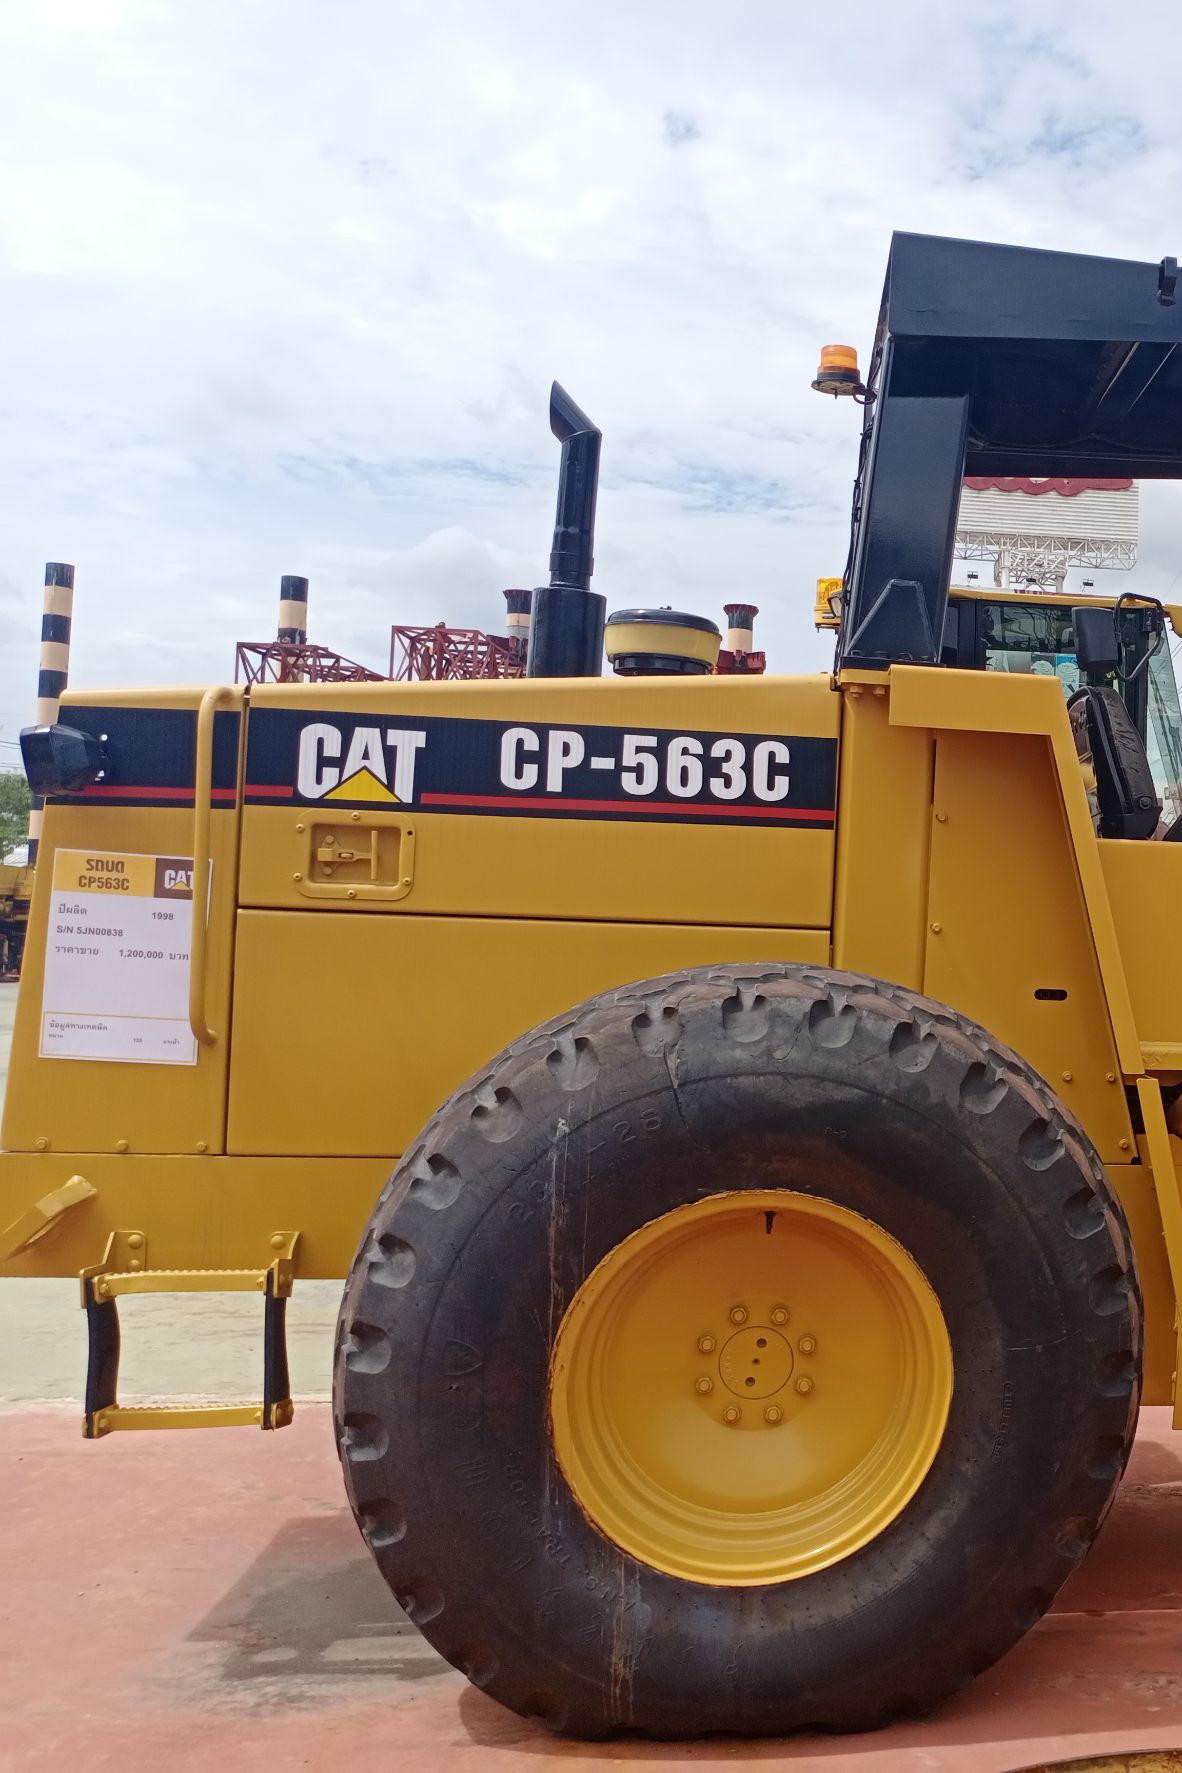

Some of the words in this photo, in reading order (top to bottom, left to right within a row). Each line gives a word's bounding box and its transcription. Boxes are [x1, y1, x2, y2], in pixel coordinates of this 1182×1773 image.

[297, 723, 427, 804] CAT
[500, 727, 790, 802] CP-563C
[85, 858, 126, 874] รถบด
[78, 875, 131, 891] CP563C
[151, 911, 175, 921] 1998
[56, 925, 75, 934] S/N
[76, 926, 125, 937] 5JN00838
[55, 945, 100, 956] ราคาขาย
[118, 949, 165, 960] 1,200,000
